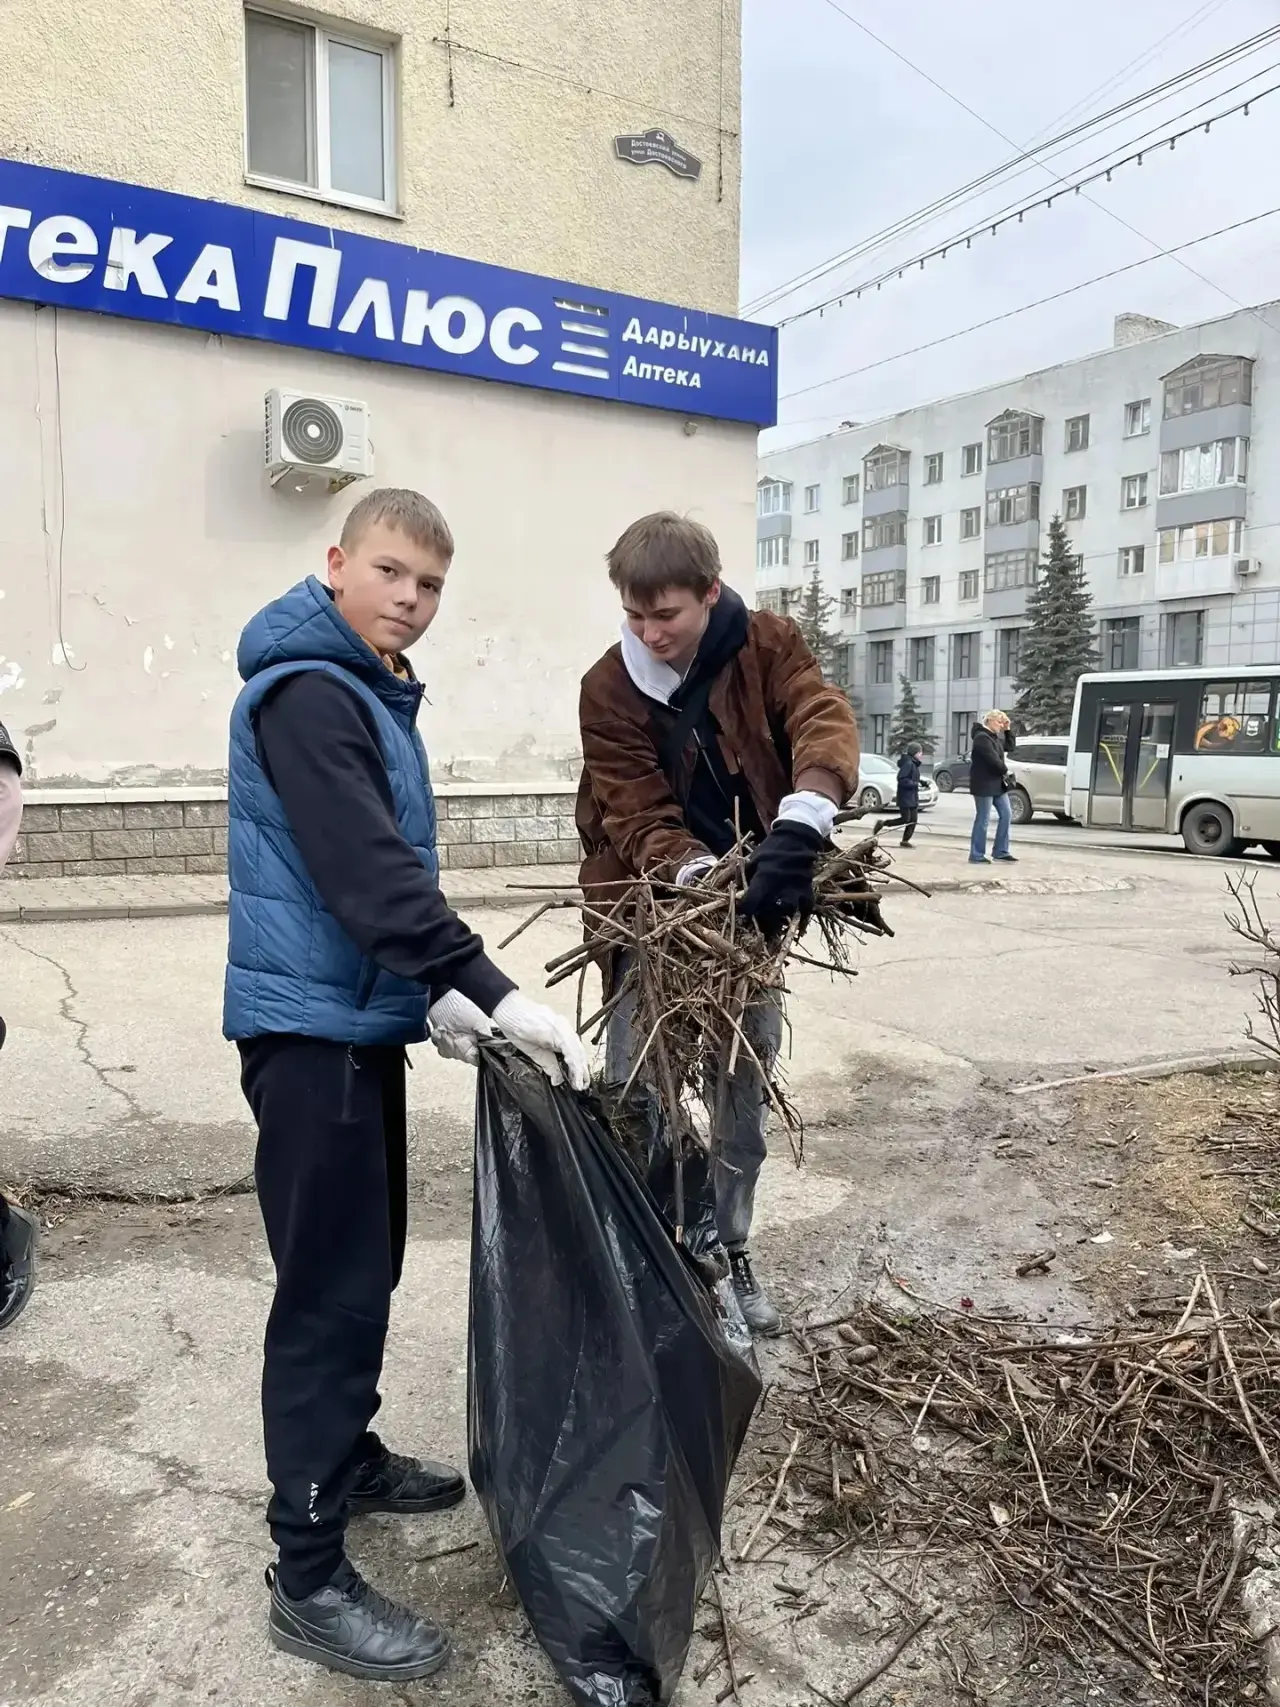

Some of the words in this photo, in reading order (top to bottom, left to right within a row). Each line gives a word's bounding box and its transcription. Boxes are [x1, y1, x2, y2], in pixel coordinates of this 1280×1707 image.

[263, 236, 543, 365] Плюс
[622, 317, 769, 367] Дарыухана
[622, 355, 701, 389] Аптека
